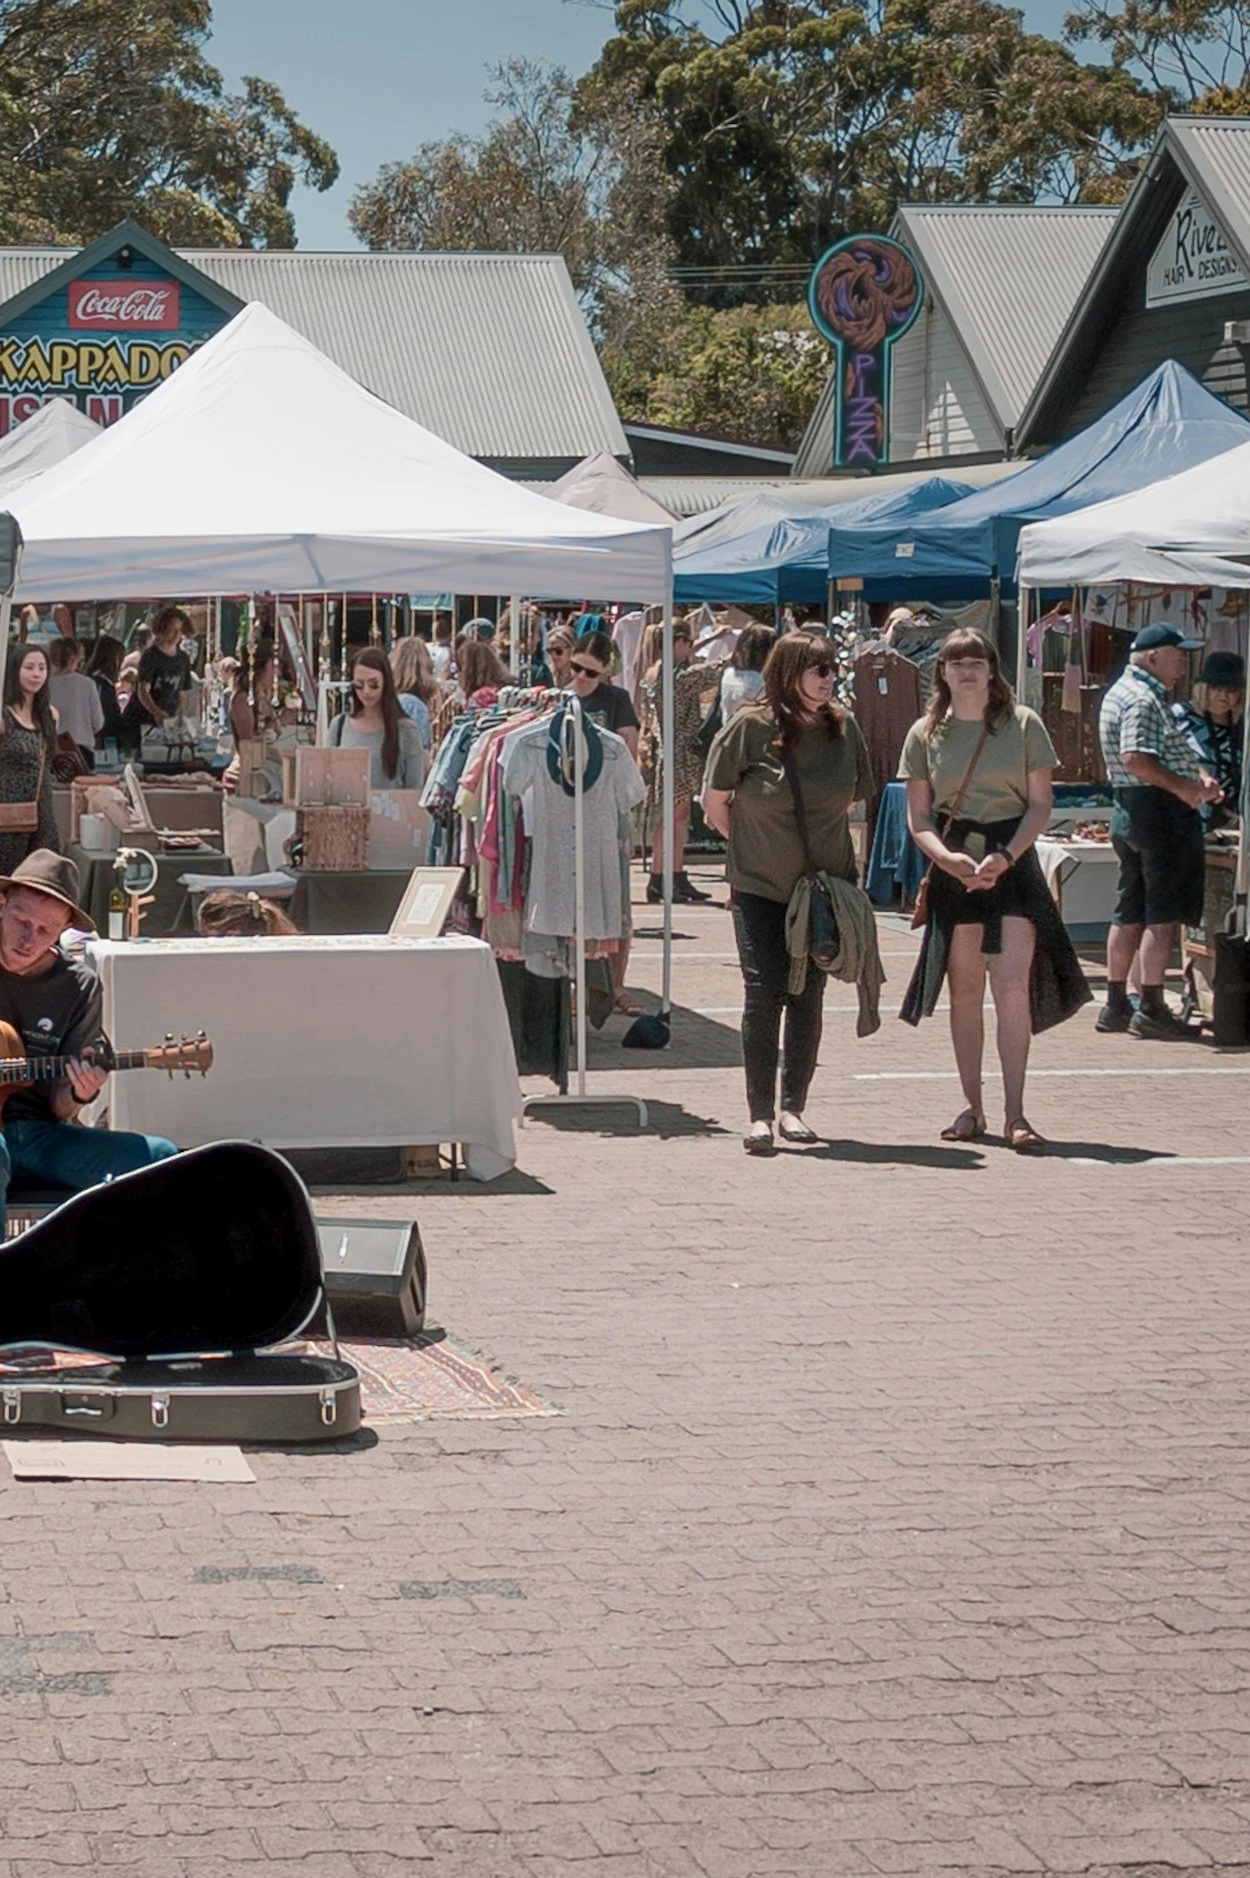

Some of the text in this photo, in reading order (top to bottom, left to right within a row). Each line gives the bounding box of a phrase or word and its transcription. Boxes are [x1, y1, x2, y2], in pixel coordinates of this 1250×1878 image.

[1164, 264, 1185, 287] HAIR
[76, 289, 170, 321] Coca-Cola
[88, 394, 123, 430] N
[848, 354, 878, 461] PIZZA
